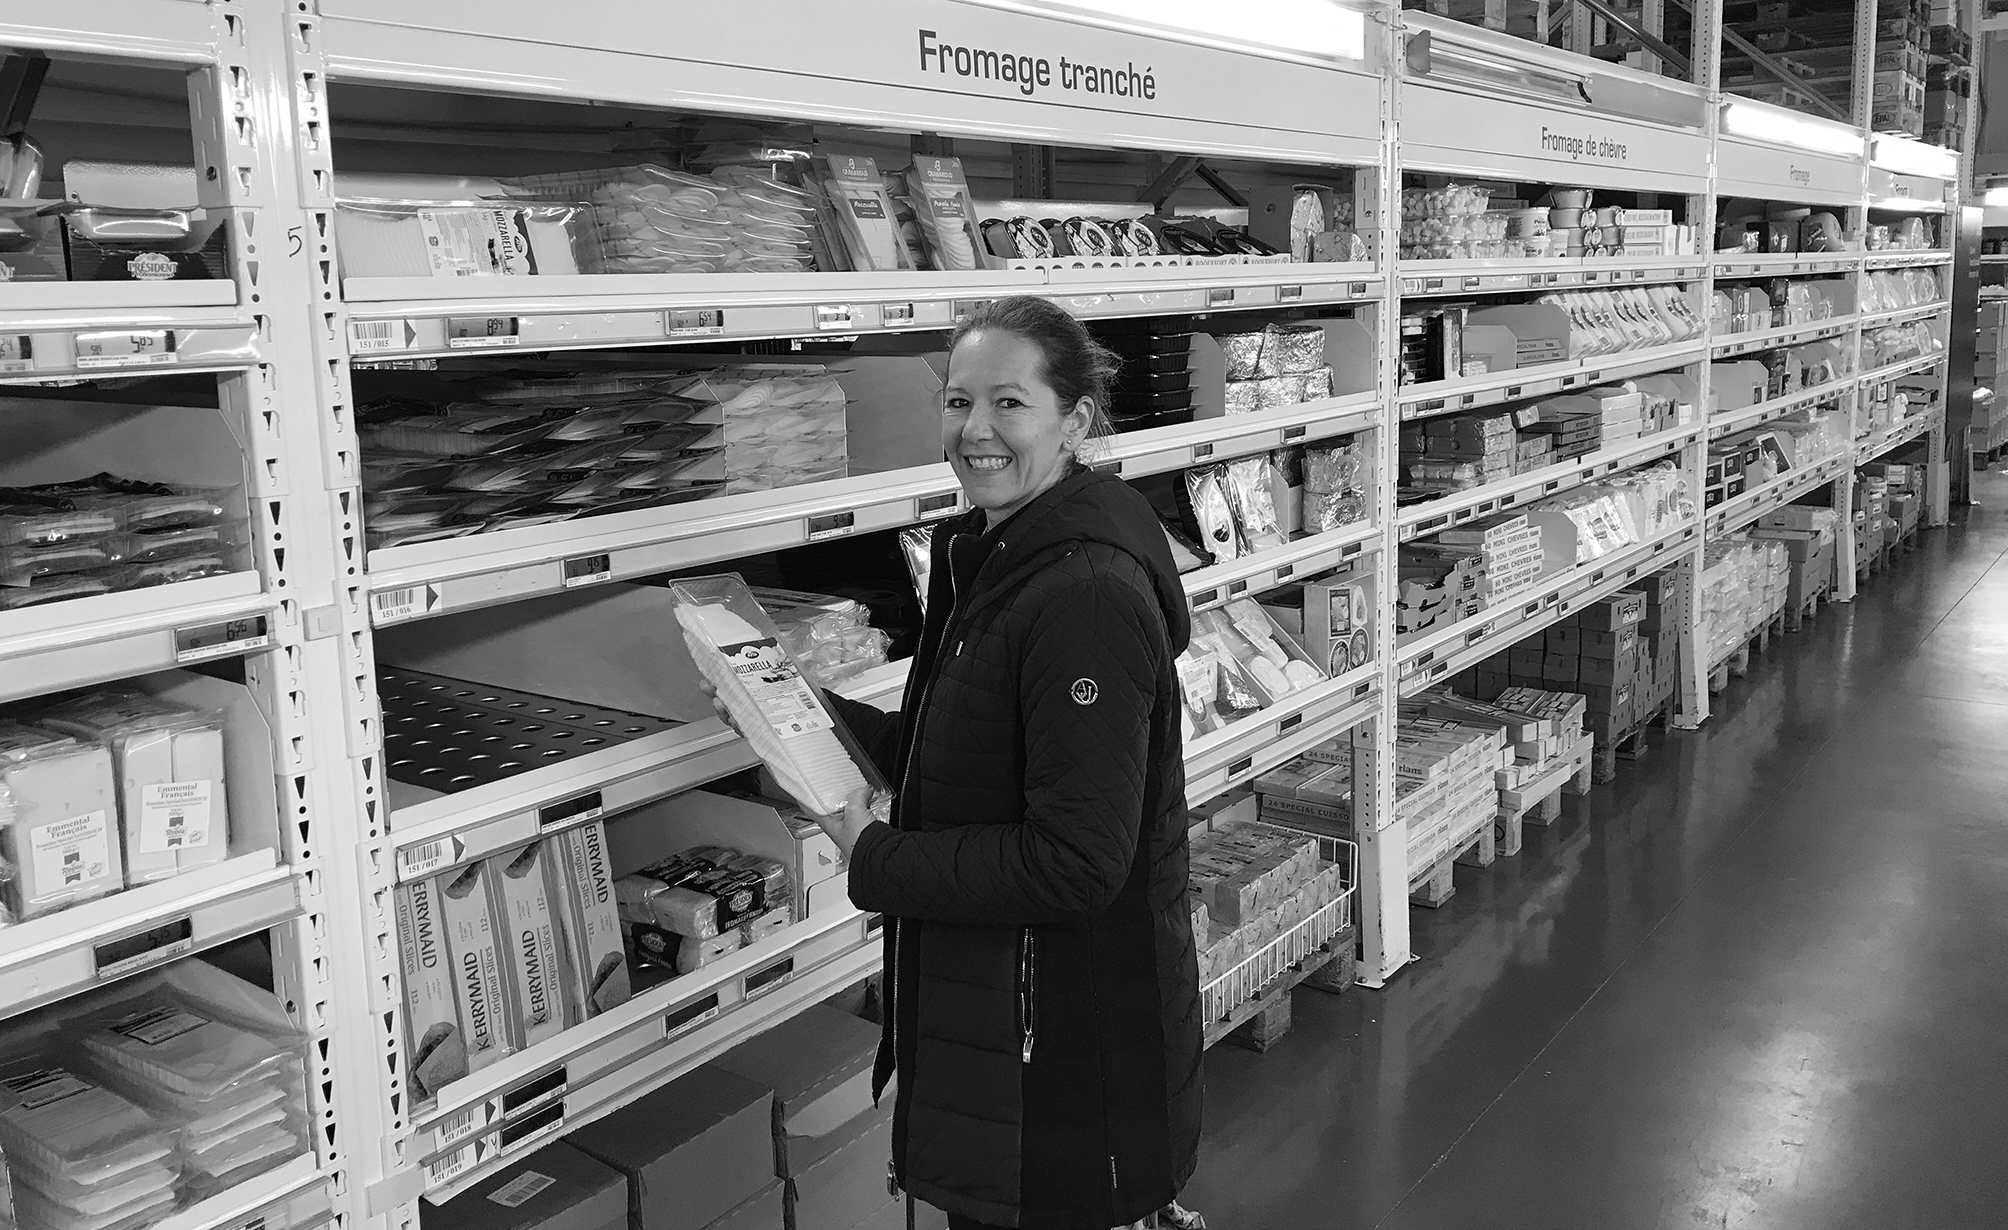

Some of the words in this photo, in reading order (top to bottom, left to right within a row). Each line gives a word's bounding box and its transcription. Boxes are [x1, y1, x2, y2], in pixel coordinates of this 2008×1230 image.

[918, 29, 1051, 95] Fromage
[1059, 56, 1156, 100] tranché
[1541, 126, 1583, 160] Fromage
[1586, 134, 1597, 156] de
[1599, 137, 1627, 159] chèvre
[1790, 164, 1810, 186] Fromage
[288, 225, 302, 258] 5
[493, 210, 514, 260] MOZZARELLA
[128, 261, 178, 273] PRÉSIDENT
[1493, 539, 1505, 547] MINI
[1507, 531, 1528, 543] CHEVRES
[1496, 552, 1507, 560] MINI
[1509, 545, 1528, 556] CHEVRES
[1496, 563, 1509, 572] MINI
[1511, 556, 1532, 567] CHEVRES
[732, 660, 773, 675] MOZZARELLA
[1320, 753, 1349, 762] SPECIA
[1398, 765, 1423, 775] rians
[156, 783, 198, 793] Emmental
[160, 791, 194, 799] Français
[1281, 802, 1316, 815] SPECIAL
[1318, 809, 1350, 820] CUISSO
[46, 815, 90, 834] Emmental
[51, 824, 88, 839] Français
[585, 825, 609, 903] ERRYMAID
[574, 845, 587, 882] Original
[581, 883, 592, 910] Slices
[537, 897, 545, 911] 112
[412, 881, 437, 969] ERRYMAID
[480, 917, 489, 933] 112
[587, 921, 595, 936] 112
[399, 904, 409, 946] Original
[406, 947, 416, 976] Slices
[542, 925, 552, 952] Slices
[485, 945, 496, 974] Slices
[522, 930, 546, 1026] KERRYMAID
[545, 952, 558, 990] Original
[410, 988, 419, 1004] 112
[464, 951, 491, 1051] KERRYMAID
[487, 975, 501, 1015] Original
